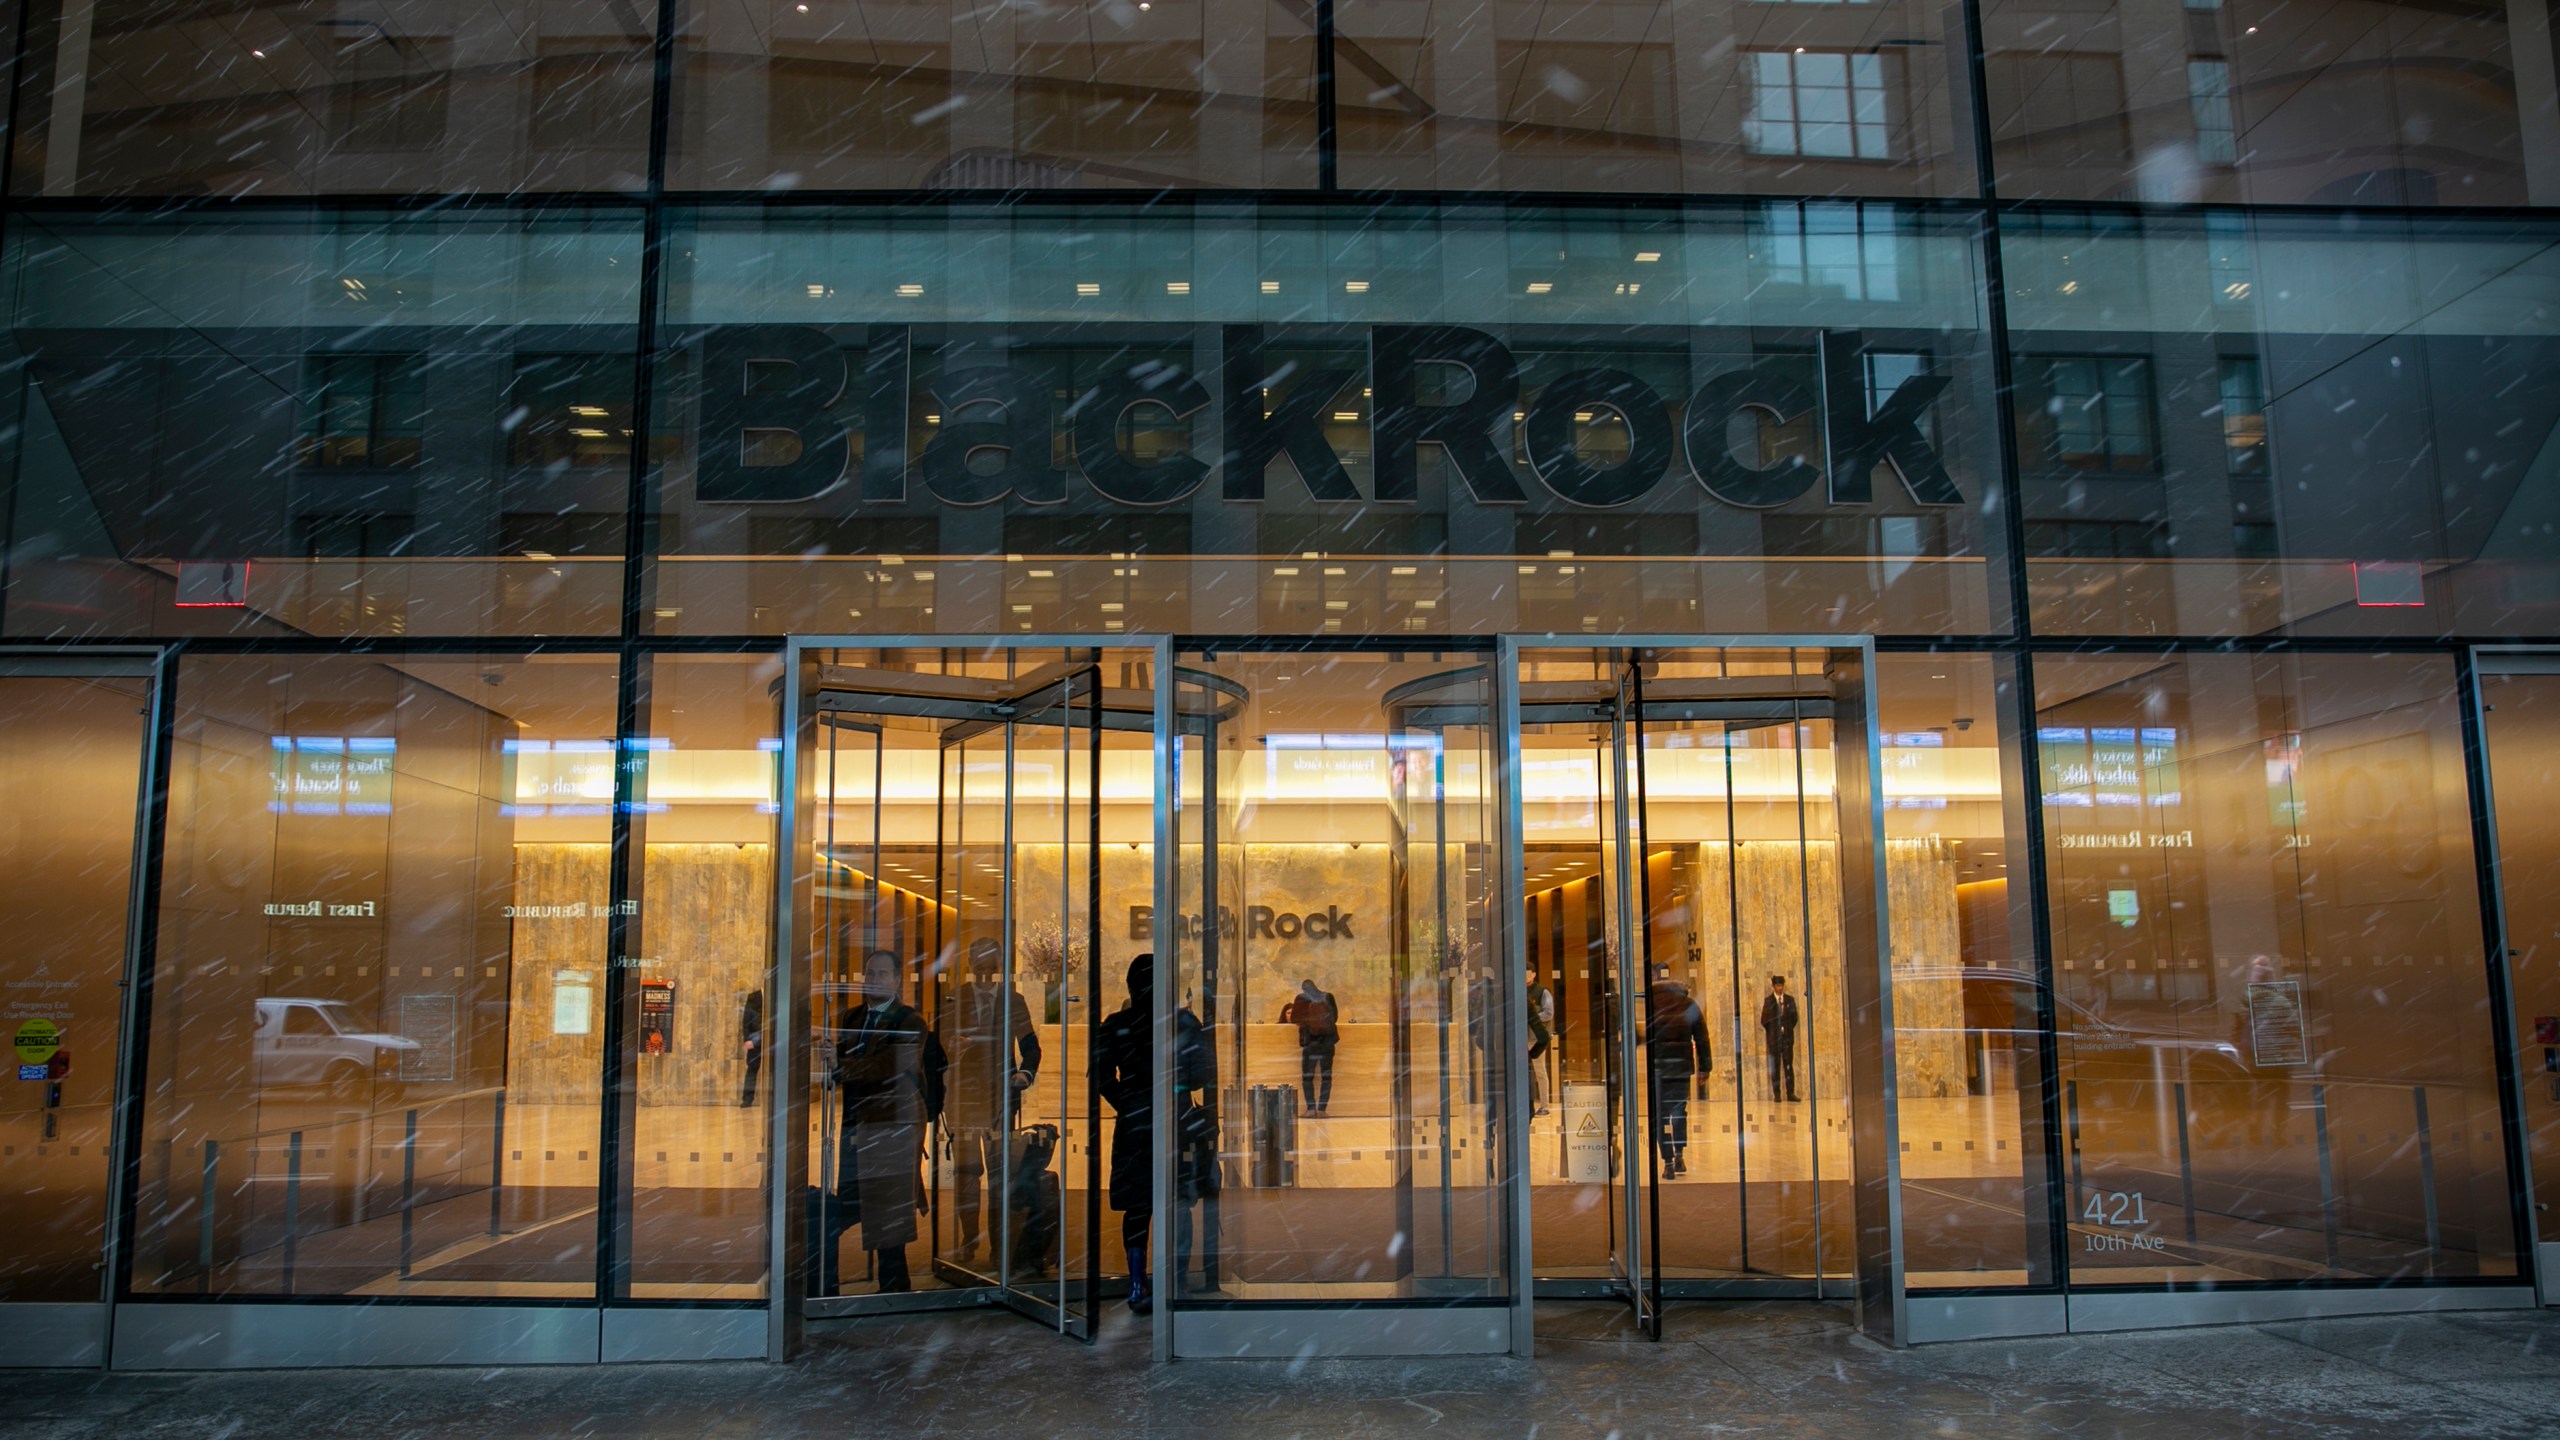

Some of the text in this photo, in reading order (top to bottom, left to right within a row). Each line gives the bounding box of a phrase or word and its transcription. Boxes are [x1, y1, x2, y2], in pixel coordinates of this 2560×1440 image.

[695, 323, 1966, 508] BlackRock
[11, 1001, 69, 1010] Emergency Exit
[56, 1011, 75, 1019] Door
[16, 1037, 57, 1045] CAUTION
[2074, 1042, 2103, 1051] building
[2084, 1192, 2149, 1225] 421
[2085, 1233, 2165, 1252] 10th Ave
